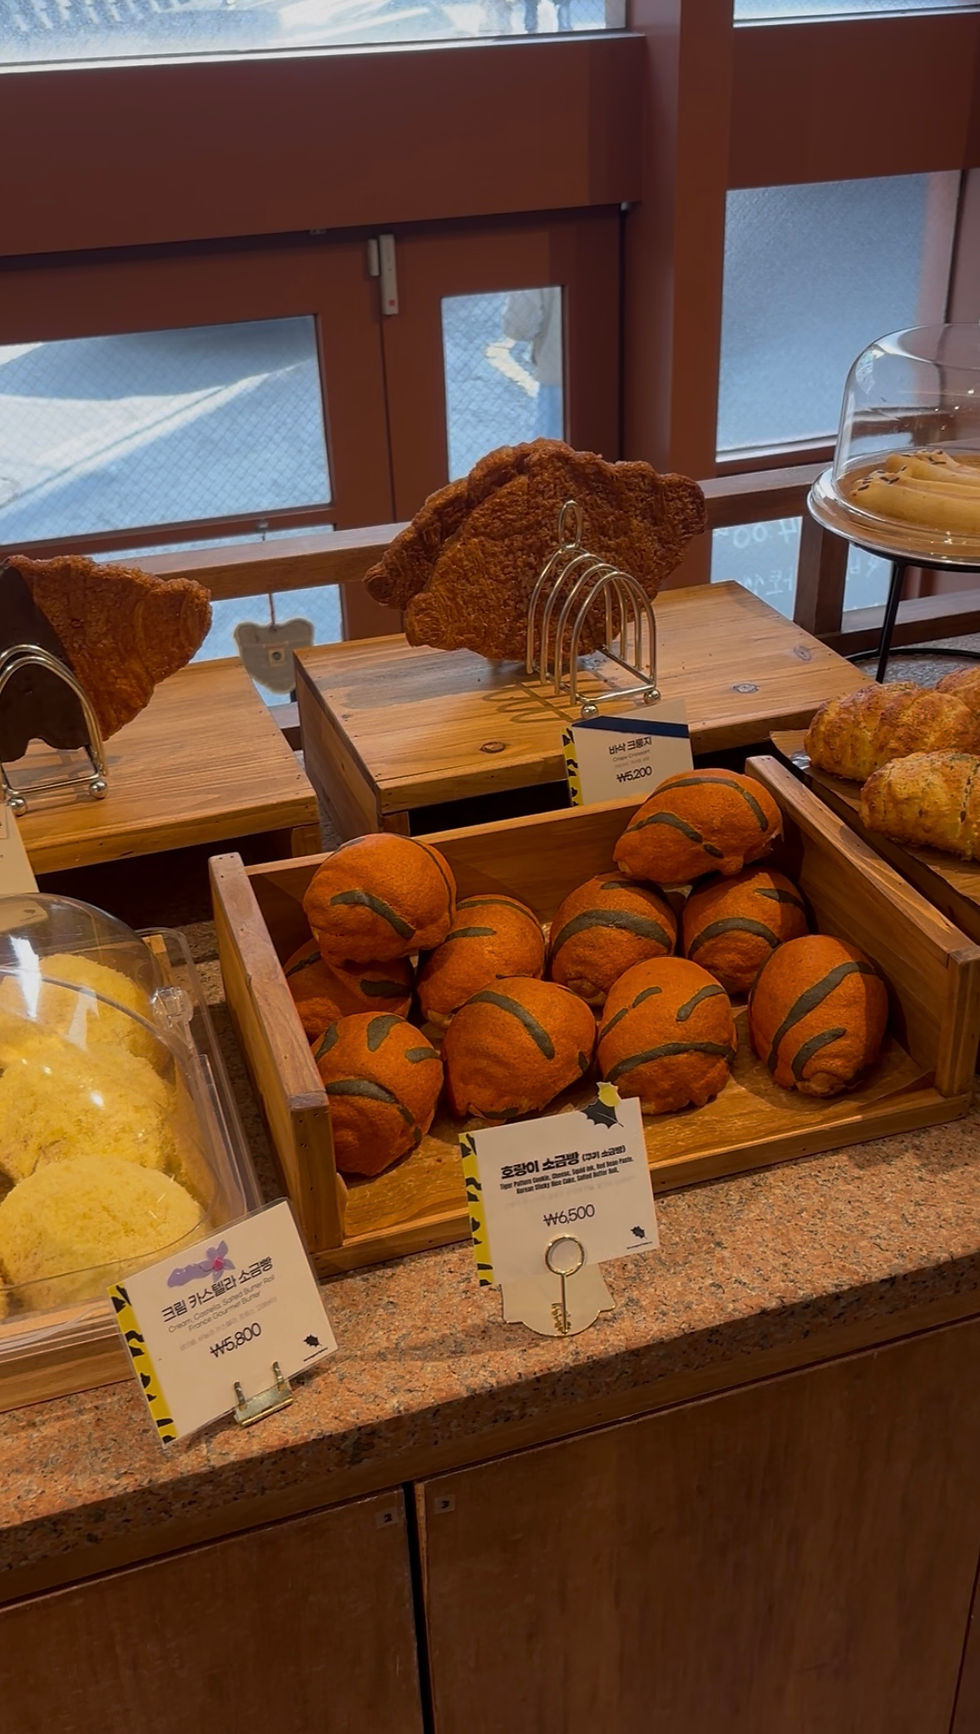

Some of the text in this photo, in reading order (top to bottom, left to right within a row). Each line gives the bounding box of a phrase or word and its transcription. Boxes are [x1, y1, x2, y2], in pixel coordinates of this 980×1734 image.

[609, 743, 626, 755] 바삭
[500, 1160, 539, 1180] 호랑이
[543, 1203, 596, 1227] ₩6,500
[161, 1256, 273, 1323] 크림 카스텔라 소금빵
[208, 1322, 262, 1358] ₩5,800
